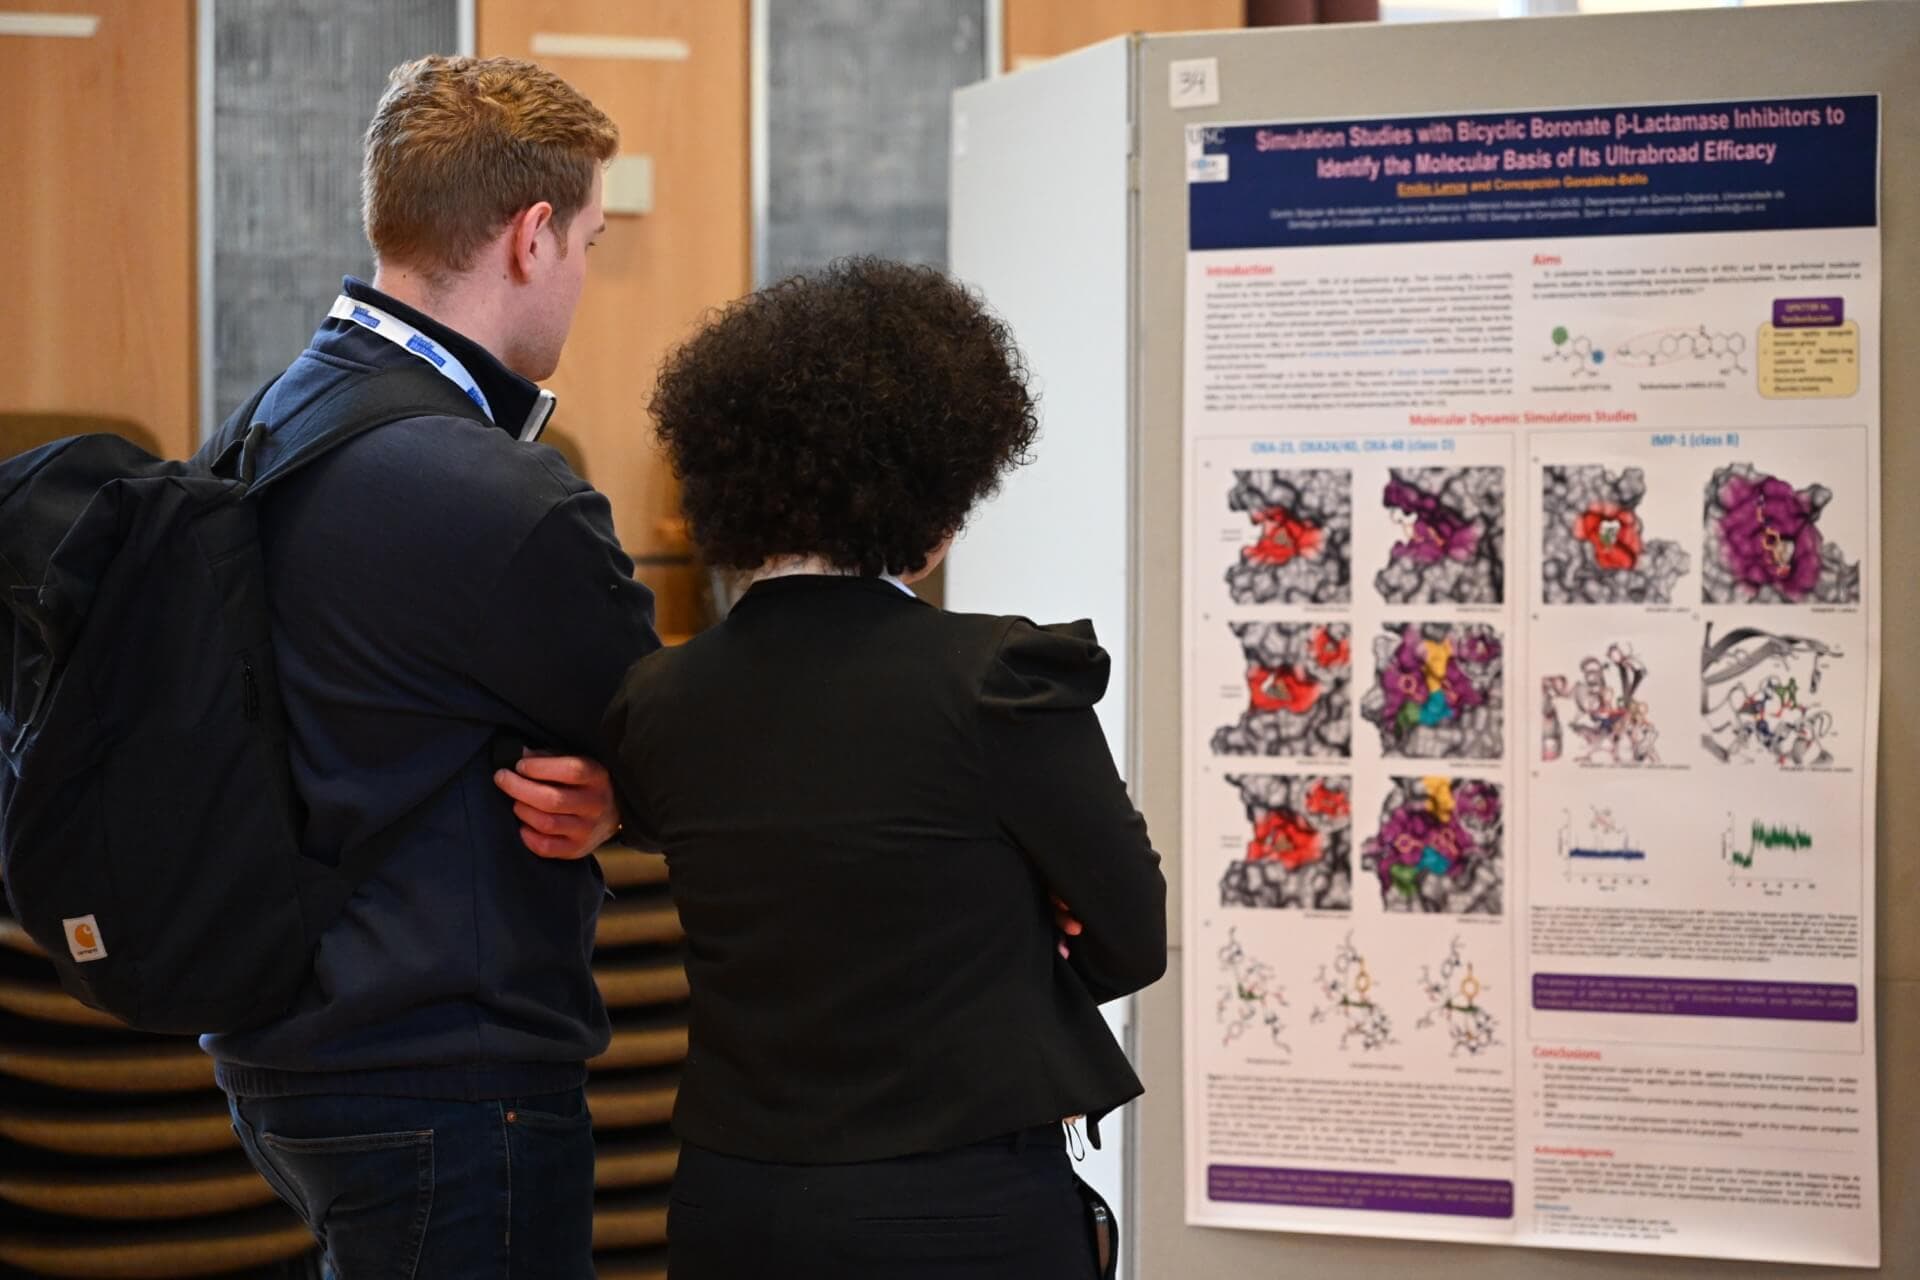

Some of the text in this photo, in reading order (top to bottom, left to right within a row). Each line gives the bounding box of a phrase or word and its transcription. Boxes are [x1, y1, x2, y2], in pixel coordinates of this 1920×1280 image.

[1256, 105, 1846, 151] Simulation Studies with Bicyclic Boronate β-Lactamase Inhibitors to
[1316, 139, 1778, 181] Identify the Molecular Basis of Its Ultrabroad Efficacy
[1470, 180, 1492, 193] and
[1532, 253, 1562, 267] Aims
[1207, 264, 1274, 276] Introduction
[1410, 408, 1637, 427] Molecular Dynamic Simulations Studies
[1532, 1045, 1601, 1060] Conclusions
